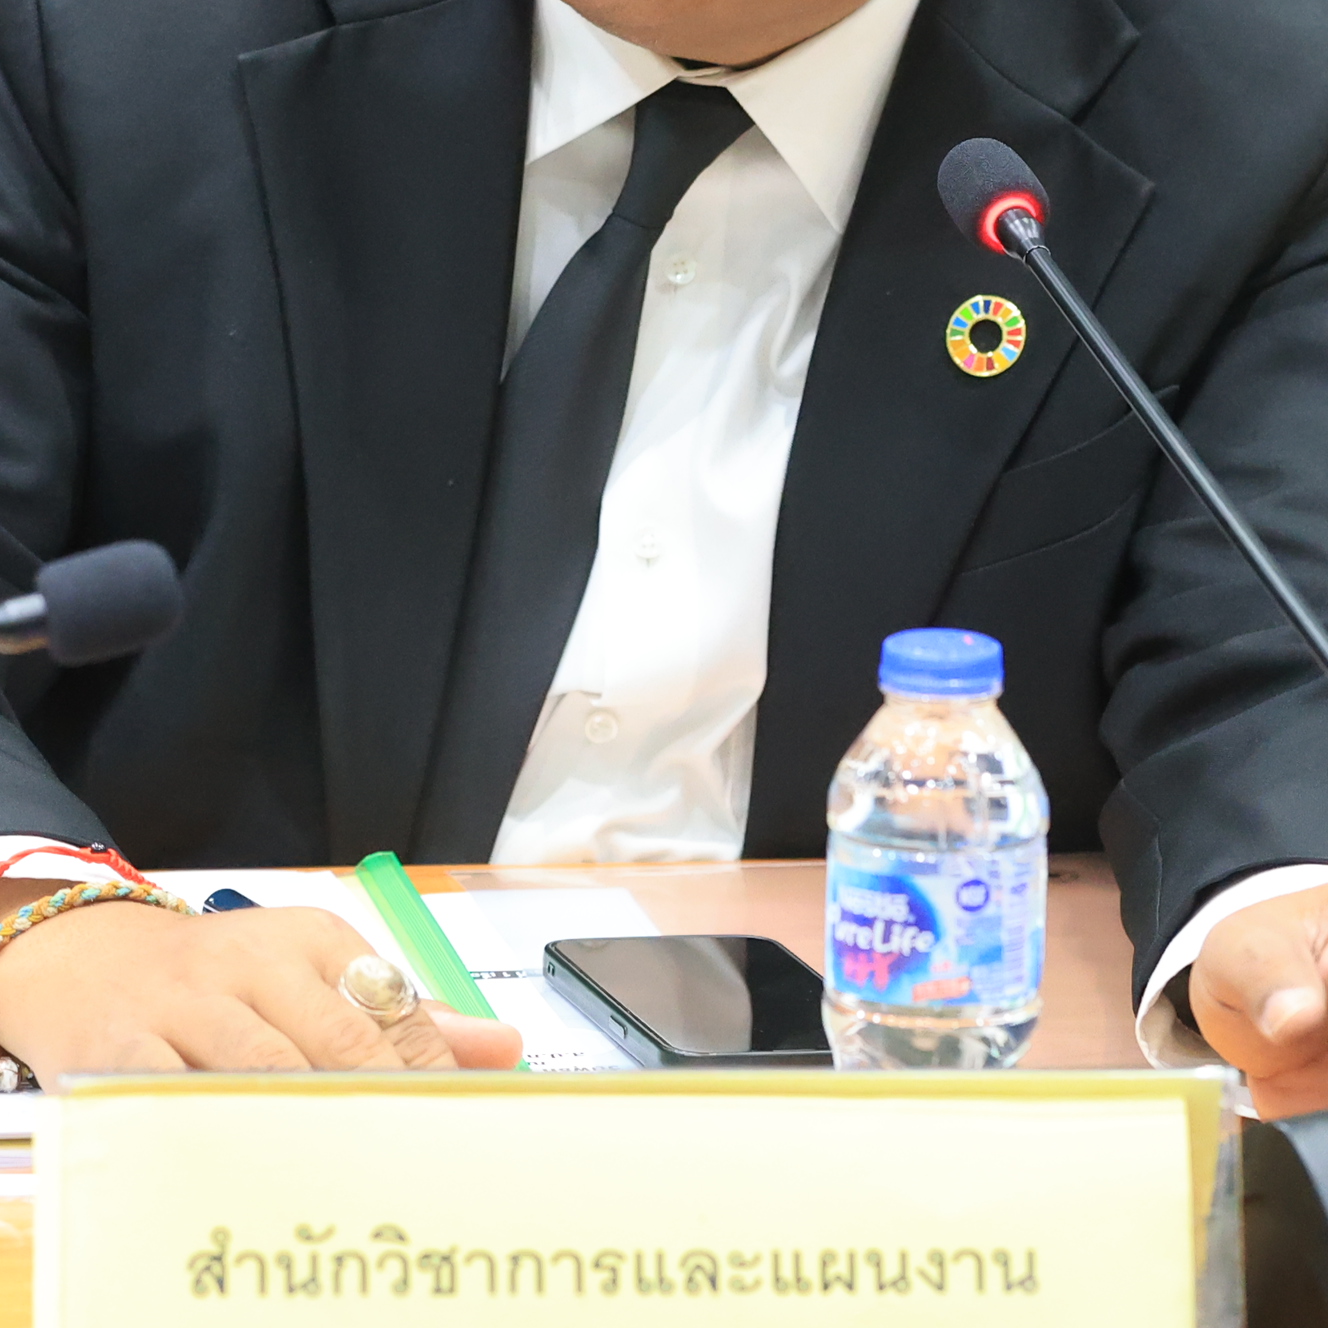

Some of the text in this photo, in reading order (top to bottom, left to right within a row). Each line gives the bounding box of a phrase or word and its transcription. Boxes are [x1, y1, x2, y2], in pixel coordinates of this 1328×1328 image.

[187, 1226, 1039, 1296] สำนักวิชาการและแผนงาน
